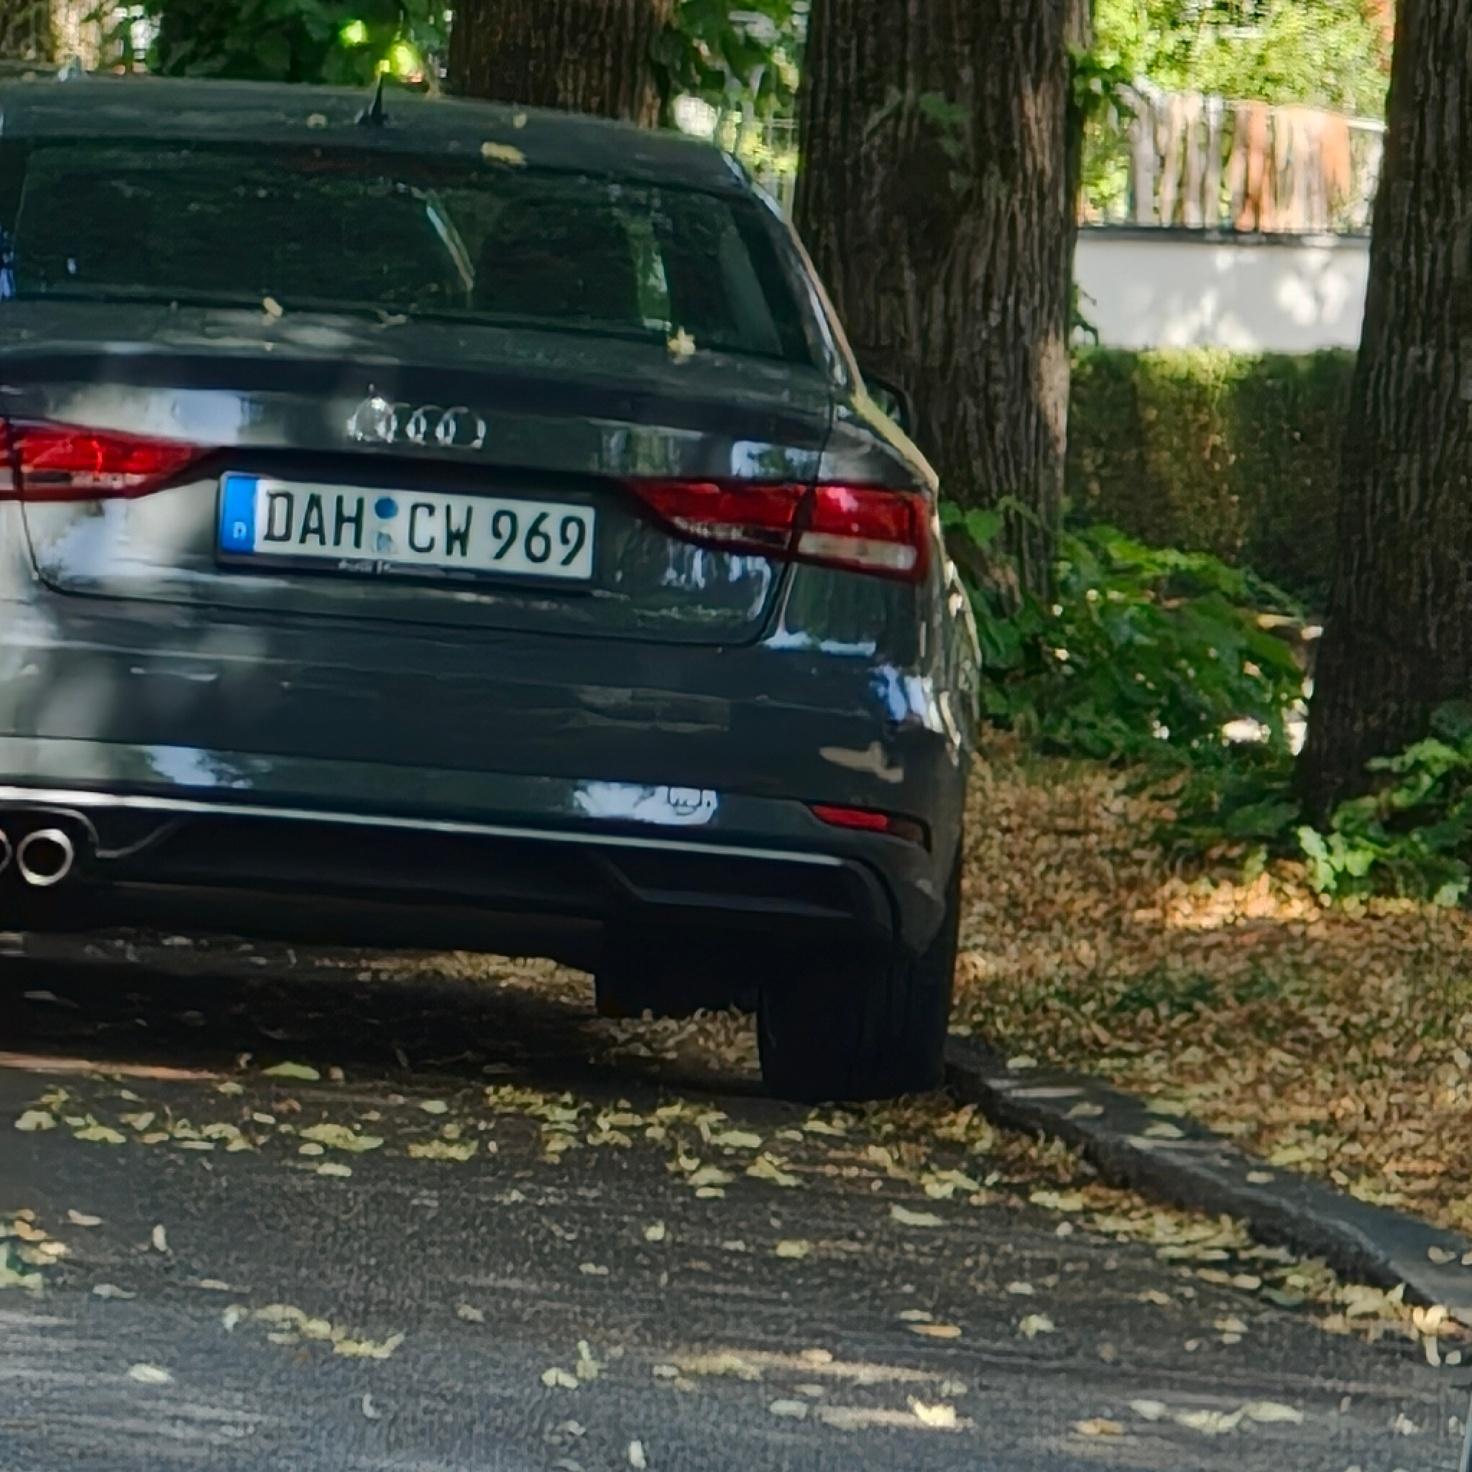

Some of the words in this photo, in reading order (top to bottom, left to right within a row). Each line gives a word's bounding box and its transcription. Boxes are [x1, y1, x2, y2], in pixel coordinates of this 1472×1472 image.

[263, 489, 365, 549] DAH
[407, 501, 473, 558] CW
[492, 509, 587, 566] 969
